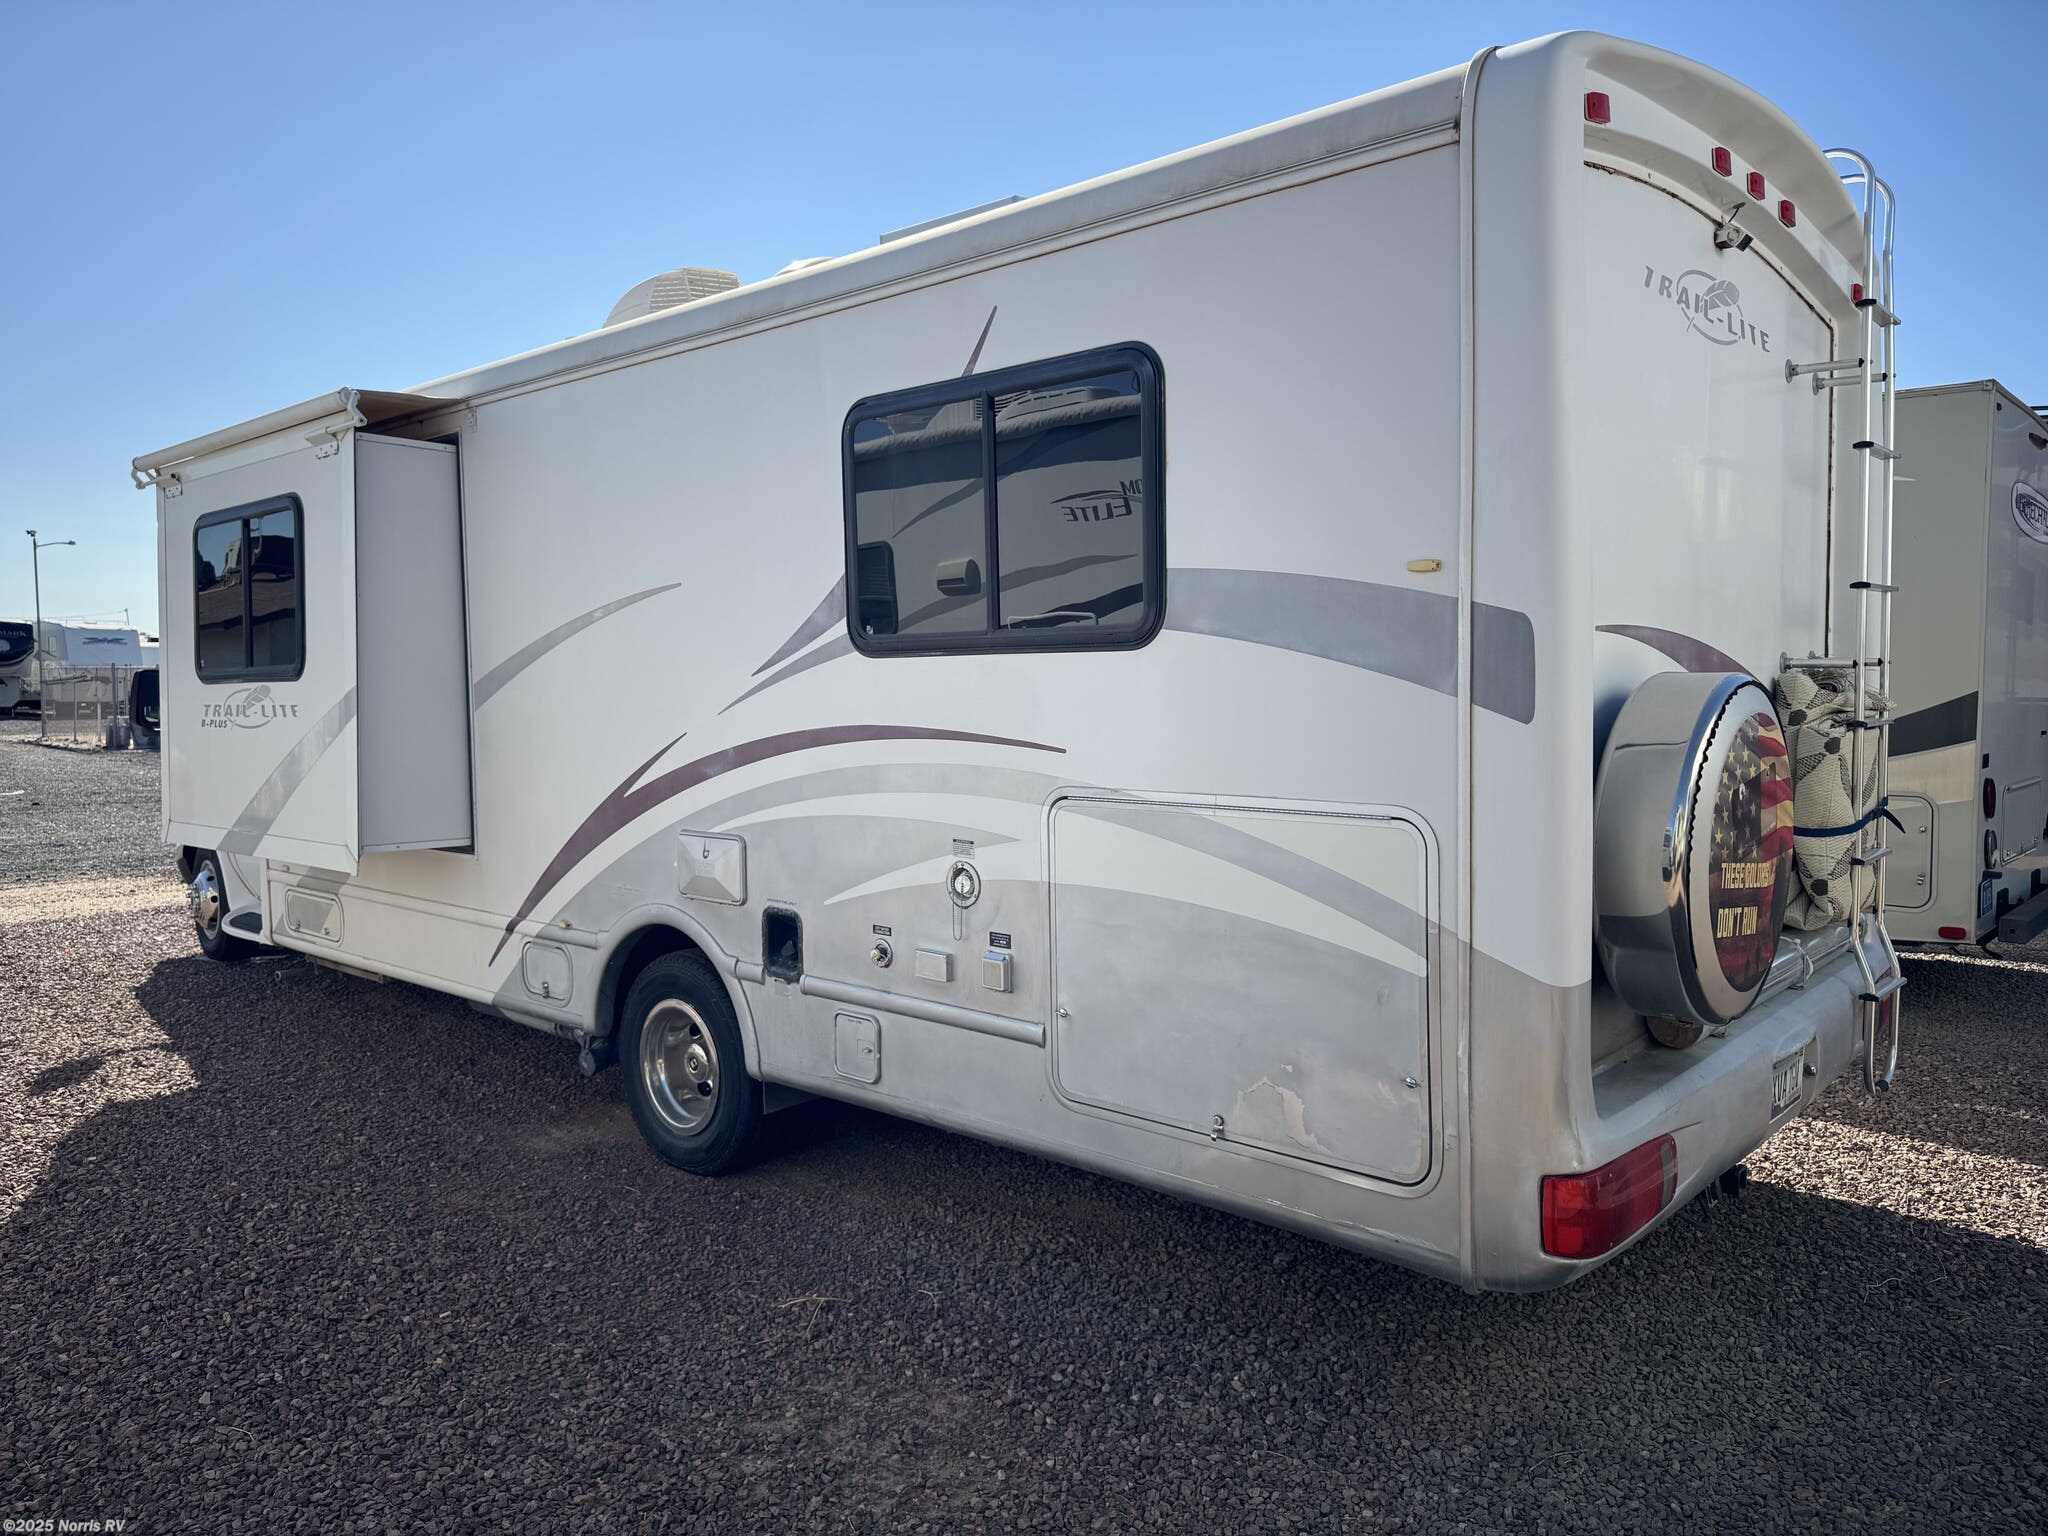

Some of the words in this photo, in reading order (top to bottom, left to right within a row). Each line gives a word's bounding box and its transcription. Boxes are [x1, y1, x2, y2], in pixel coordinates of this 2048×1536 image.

[1721, 862, 1744, 889] THESE
[1716, 907, 1742, 939] DON'T
[1742, 906, 1758, 936] RUN
